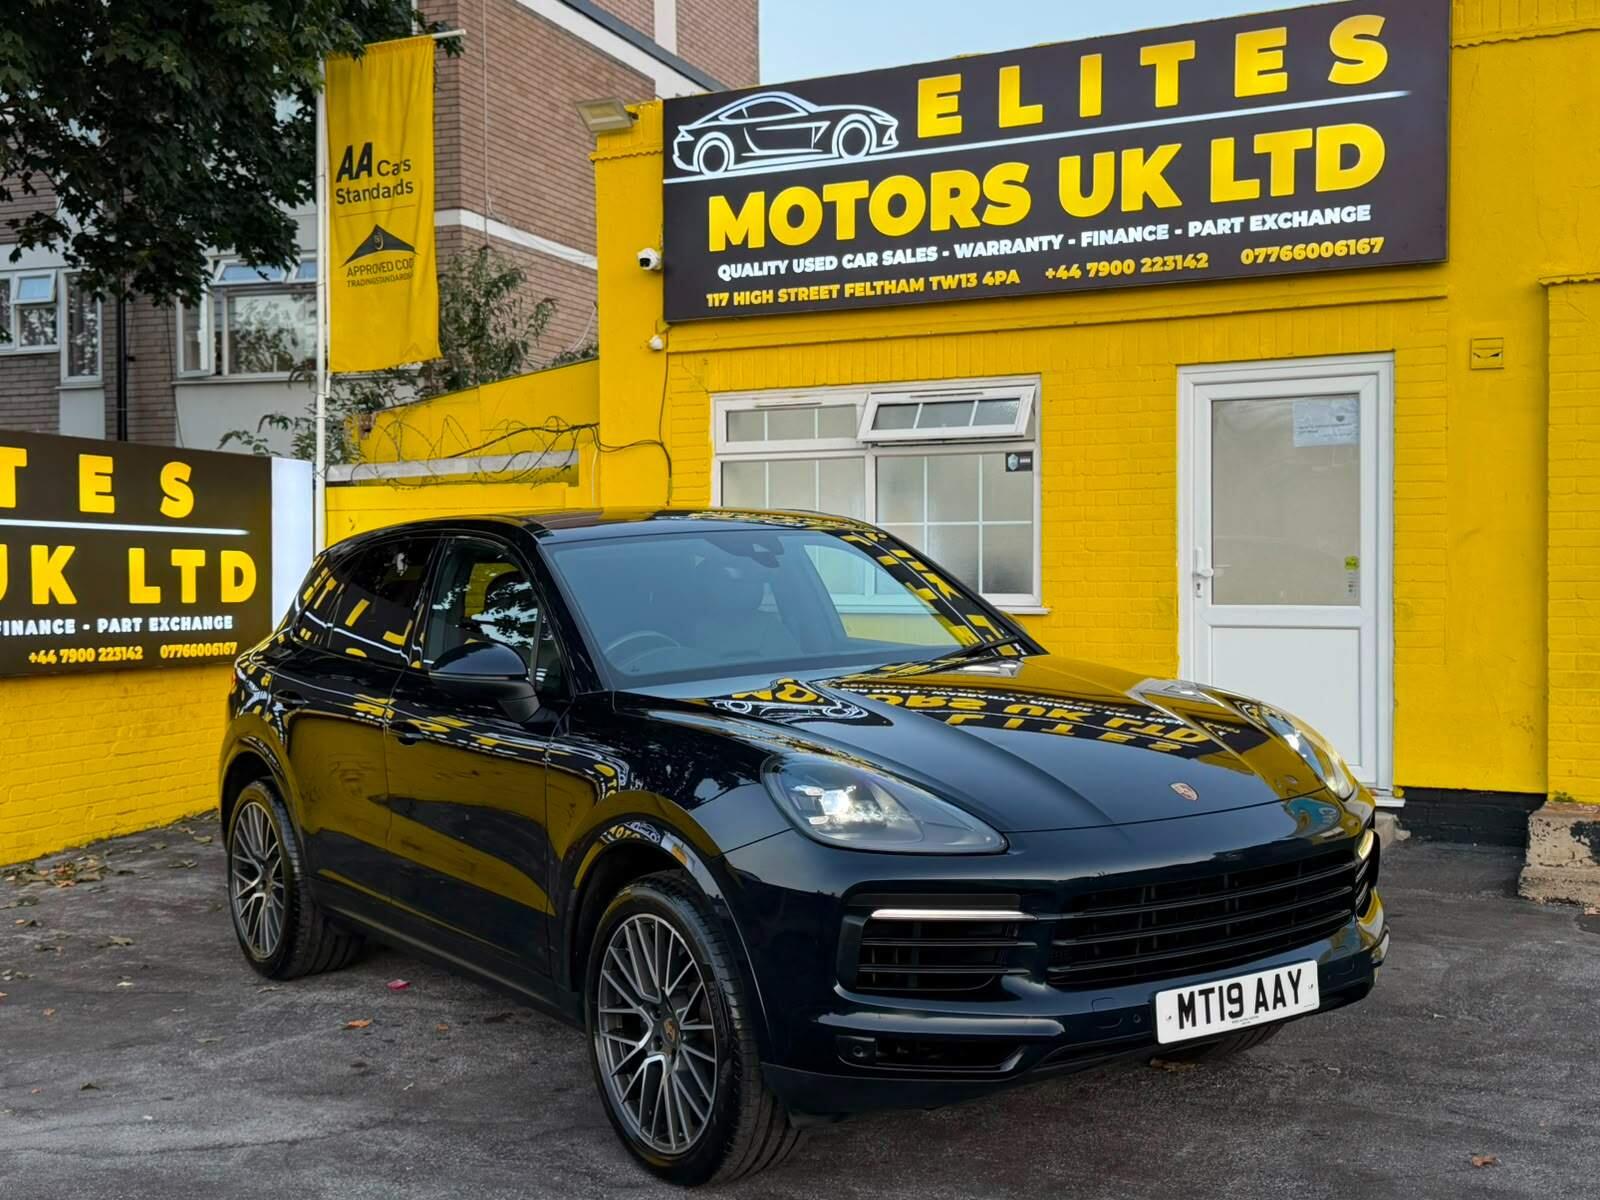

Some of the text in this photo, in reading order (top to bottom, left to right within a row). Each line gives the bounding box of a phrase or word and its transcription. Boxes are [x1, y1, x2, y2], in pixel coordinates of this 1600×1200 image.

[917, 14, 1388, 138] ELITES
[336, 142, 373, 183] AA
[708, 123, 1386, 252] MOTORS UK LTD
[717, 259, 789, 281] QUALITY
[792, 255, 838, 273] USED
[842, 252, 878, 269] CAR
[882, 246, 938, 266] SALES
[954, 234, 1064, 259] WARRANTY
[1081, 224, 1169, 247] FINANCE
[1188, 216, 1244, 237] PART
[1249, 204, 1371, 232] EXCHANGE
[1240, 237, 1385, 265] 07766006167
[1045, 252, 1209, 279] +44 7900 223142
[706, 269, 1021, 307] 117 HIGH STREET FELTHAM TW13 4PA
[0, 543, 257, 605] K LTD
[0, 619, 76, 636] INANCE
[97, 617, 142, 633] PART
[148, 615, 233, 632] EXCHANGE
[28, 646, 144, 664] +44 7900 223142
[160, 642, 237, 659] 07766006167
[1177, 968, 1302, 1030] MT19 AAY
